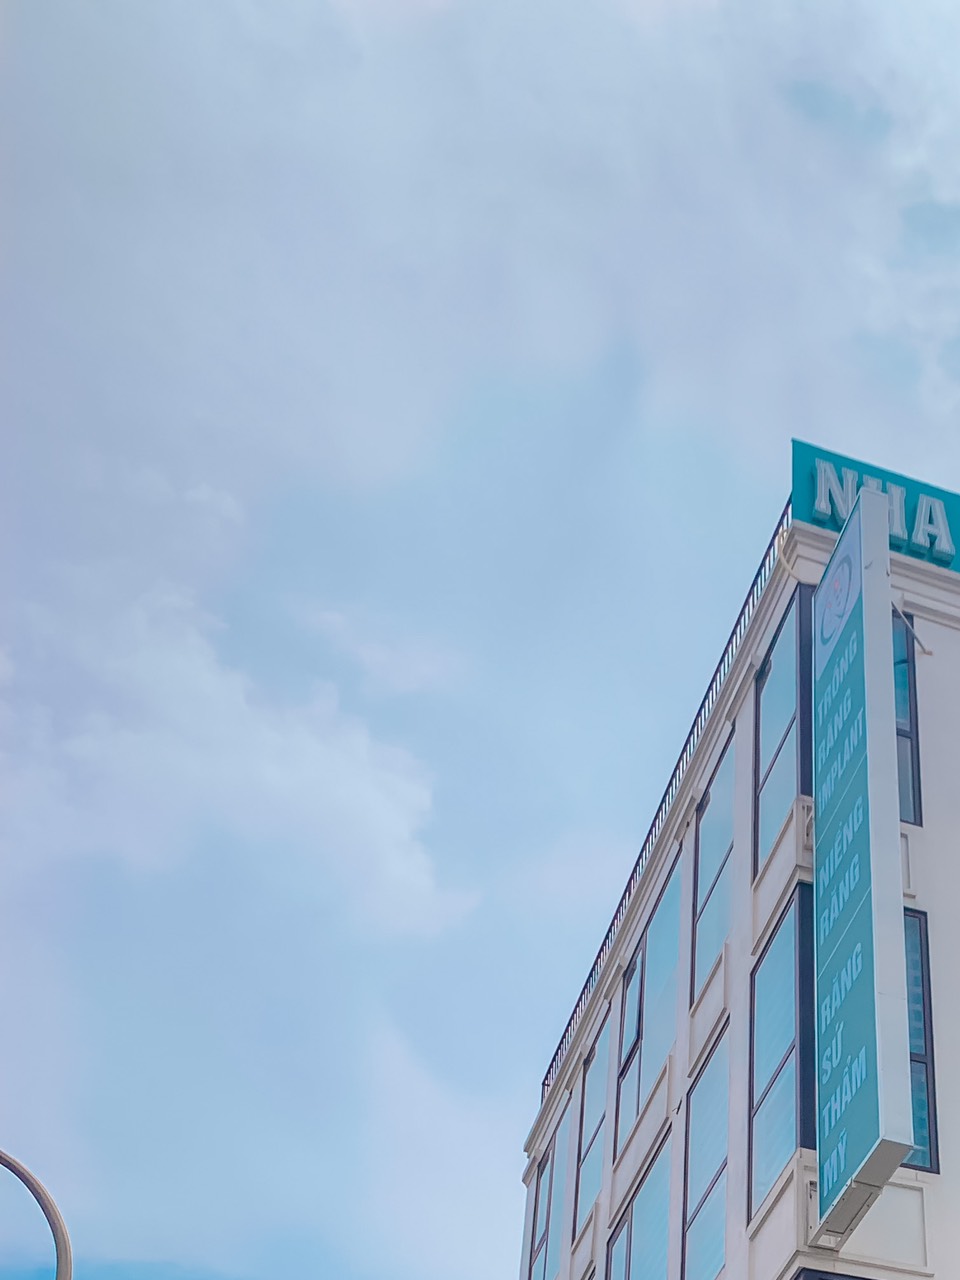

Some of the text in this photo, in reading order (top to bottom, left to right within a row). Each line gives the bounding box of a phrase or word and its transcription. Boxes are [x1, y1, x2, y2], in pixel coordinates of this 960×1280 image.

[814, 458, 956, 560] NHA
[818, 705, 865, 818] IMPLANT
[819, 853, 860, 947] RĂNG
[820, 942, 862, 1035] RĂNG
[821, 1020, 844, 1085] SỨ
[823, 1127, 848, 1198] MỸ
